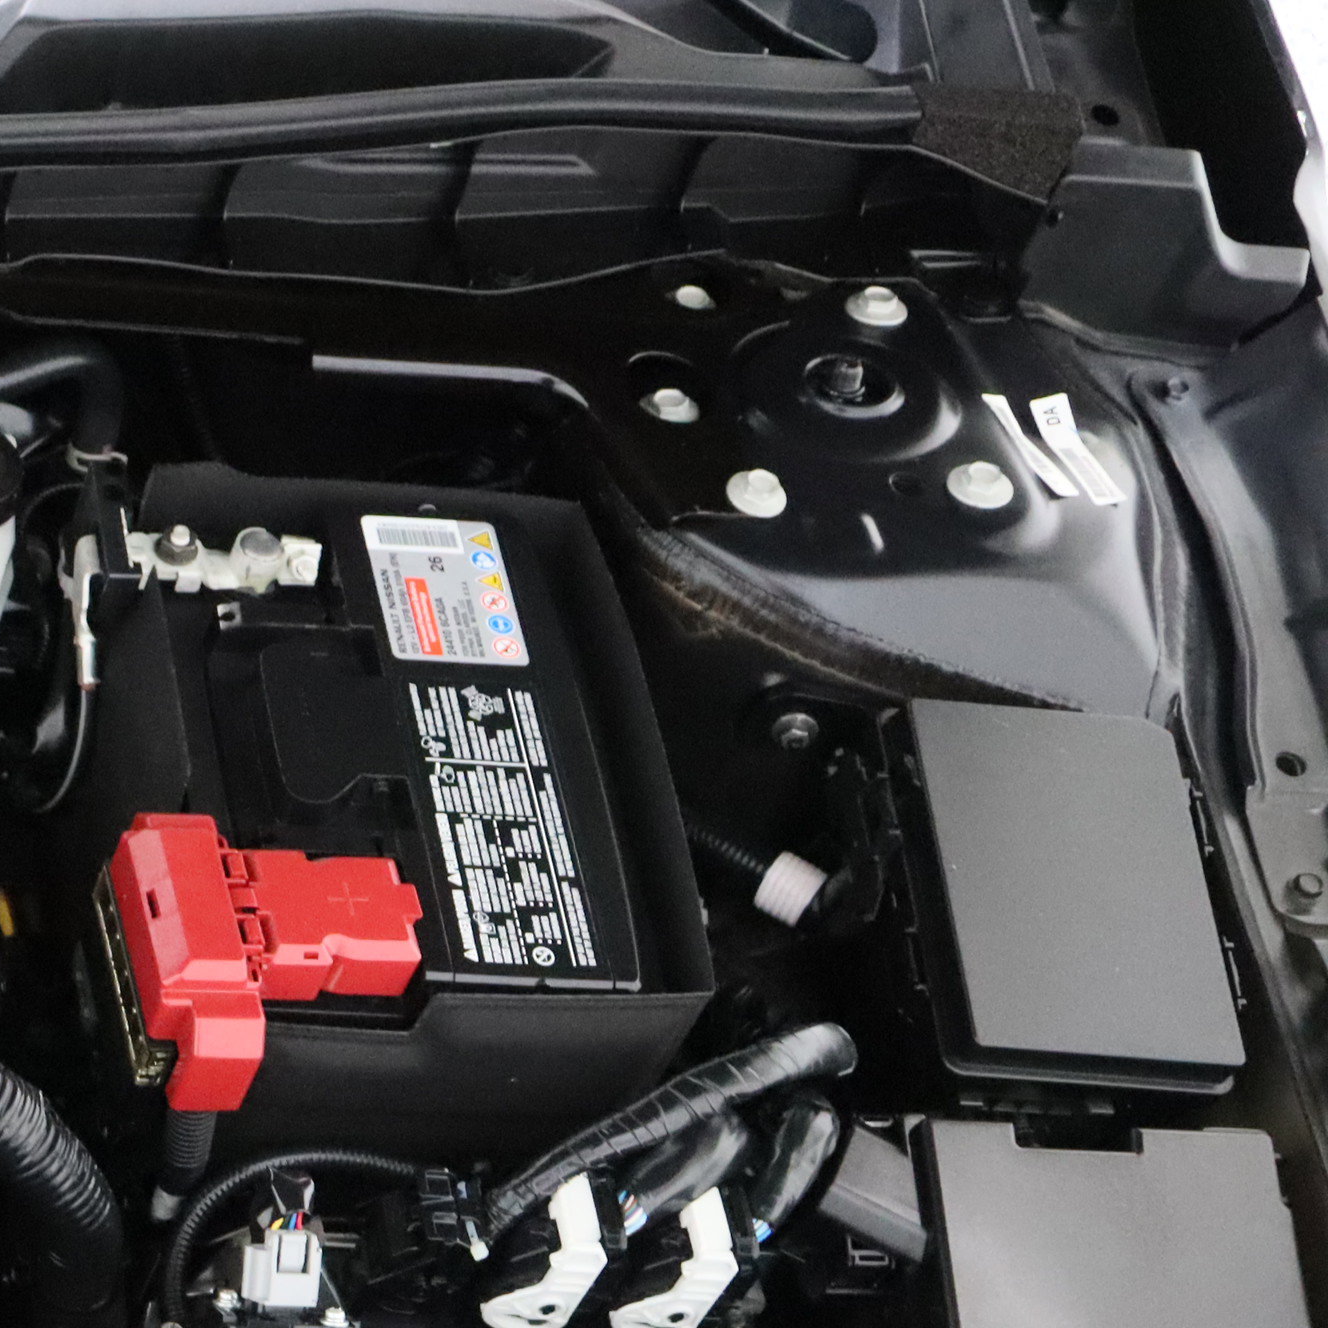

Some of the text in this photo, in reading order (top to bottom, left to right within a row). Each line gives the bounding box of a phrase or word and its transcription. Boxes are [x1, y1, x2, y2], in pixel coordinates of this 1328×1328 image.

[1043, 406, 1061, 425] DA
[428, 555, 444, 572] 26
[380, 569, 395, 609] NISSAN
